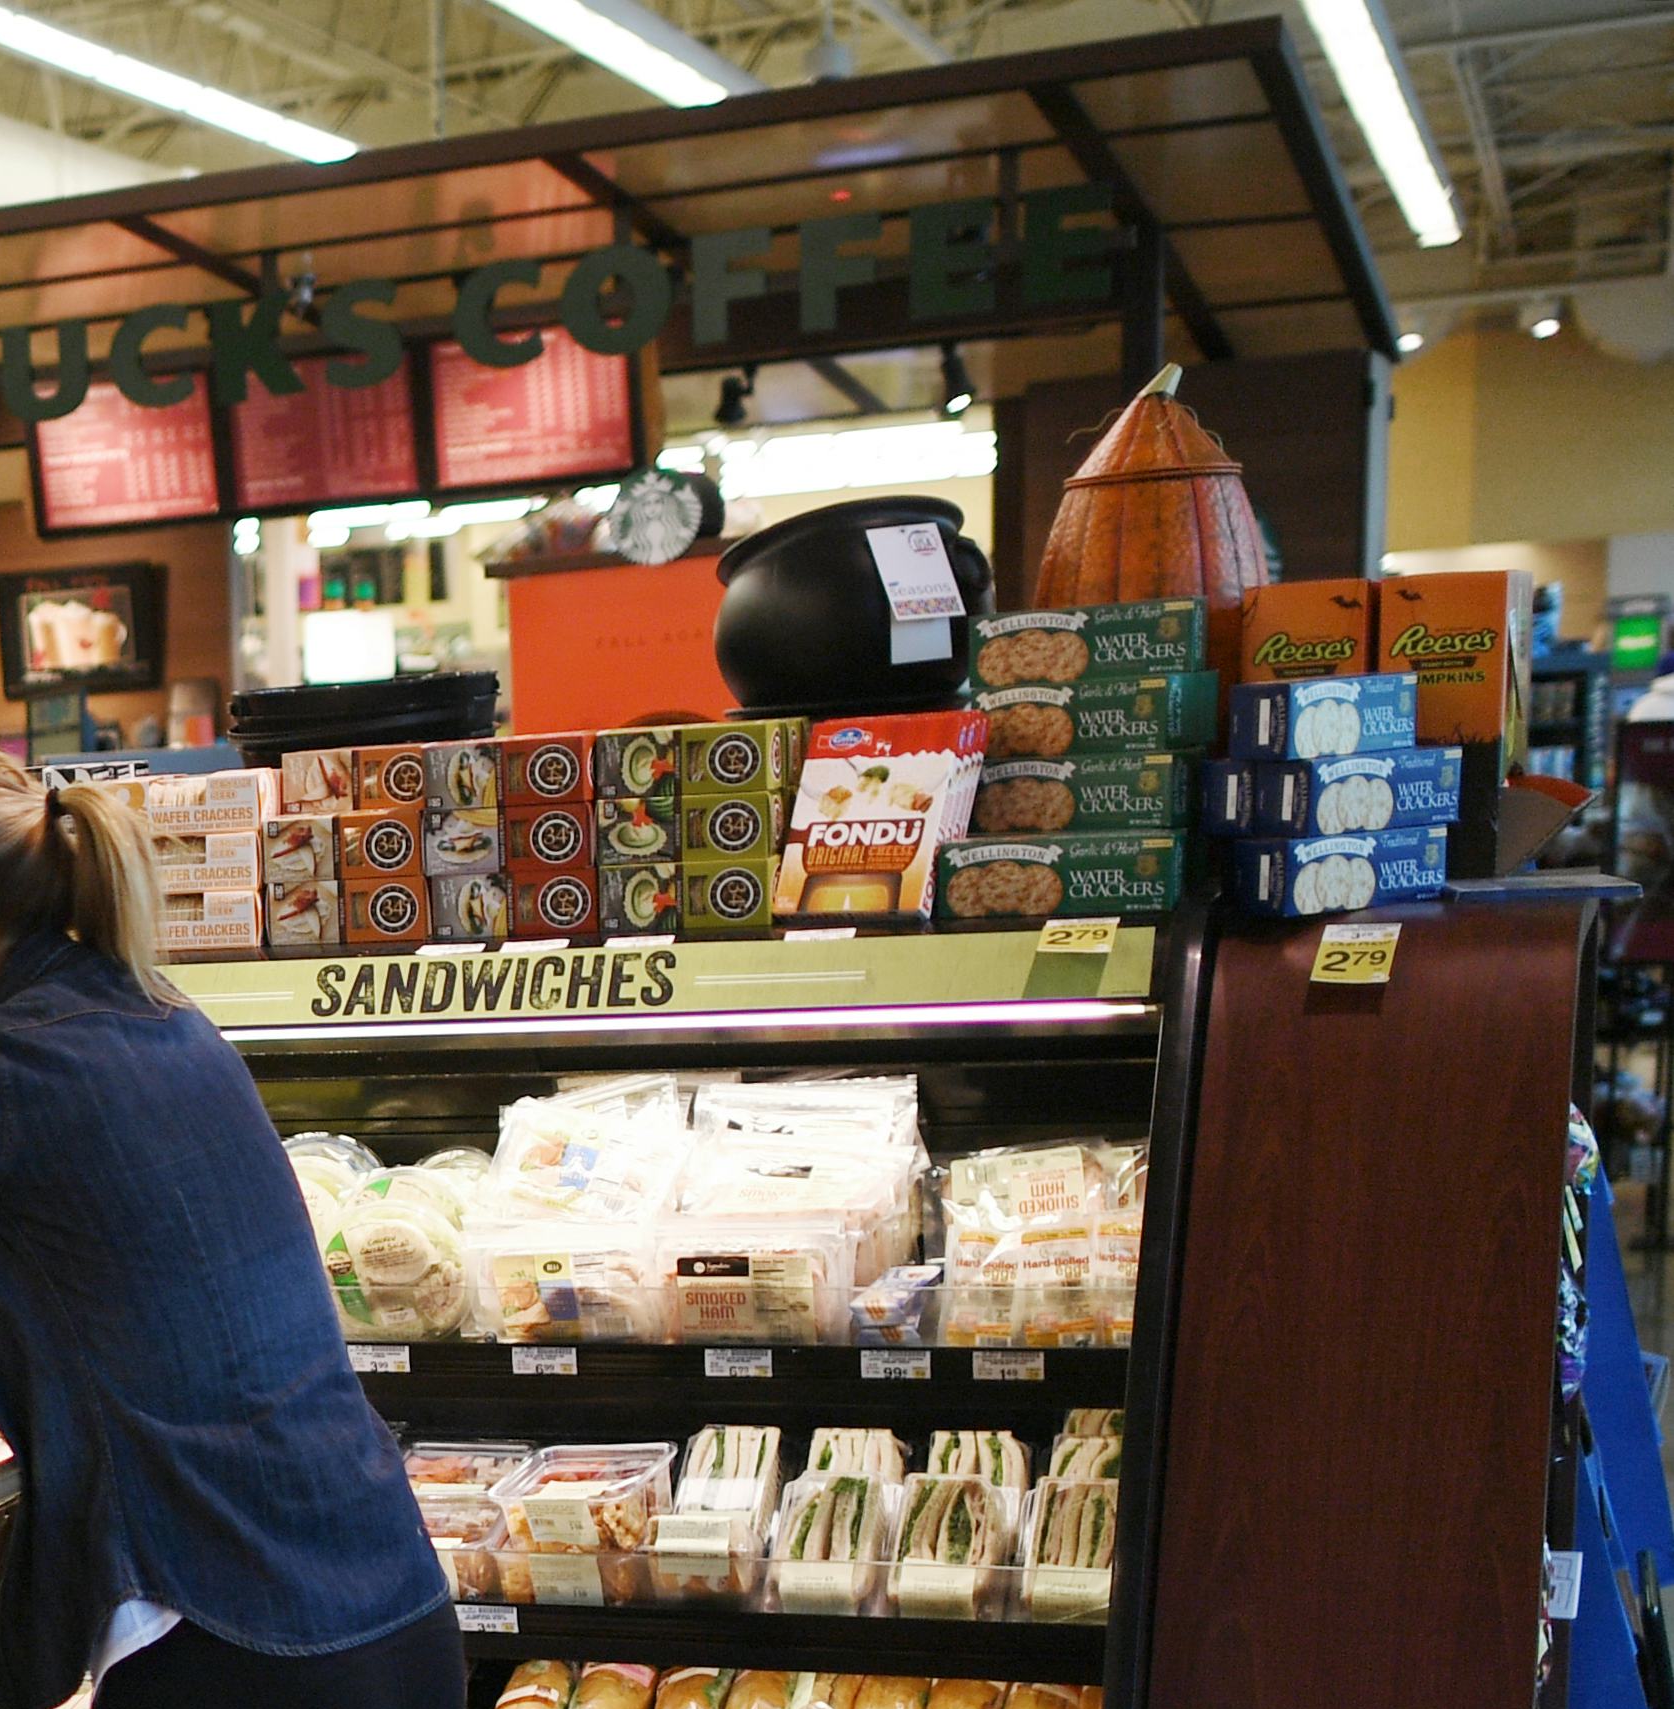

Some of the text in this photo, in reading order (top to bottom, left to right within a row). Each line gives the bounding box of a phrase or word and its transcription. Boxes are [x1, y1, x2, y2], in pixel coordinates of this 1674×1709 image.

[456, 184, 1113, 367] COFFEE
[890, 582, 952, 597] seasons
[989, 615, 1072, 633] WELLINGTON
[1095, 632, 1150, 649] WATER
[1094, 642, 1186, 662] CRACKERS
[1079, 709, 1126, 725] WATER
[1364, 706, 1395, 722] WATER
[1078, 720, 1158, 738] CRACKERS
[1363, 717, 1414, 737] CRACKERS
[985, 762, 1061, 780] WELLINGTON
[1080, 785, 1129, 801] WATER
[1398, 780, 1434, 797] WATER
[1080, 796, 1163, 814] CRACKERS
[1397, 791, 1458, 812] CRACKERS
[152, 806, 253, 826] WAFER CRACKERS
[807, 845, 866, 865] ORIGINAL
[960, 848, 1046, 865] WELLINGTON
[193, 865, 252, 881] CRACKERS
[1380, 859, 1417, 876] WATER
[1069, 869, 1126, 887] WATER
[1379, 868, 1443, 890] CRACKERS
[1069, 881, 1165, 899] CRACKERS
[191, 922, 251, 938] CRACKERS
[310, 950, 676, 1017] SANDWICHES
[1029, 1182, 1066, 1198] HAM
[1018, 1197, 1080, 1214] SMOKED
[1023, 1256, 1090, 1272] Hard-Boiled
[1055, 1265, 1090, 1282] eggs
[685, 1290, 747, 1306] SMOKED
[701, 1306, 736, 1320] HAM
